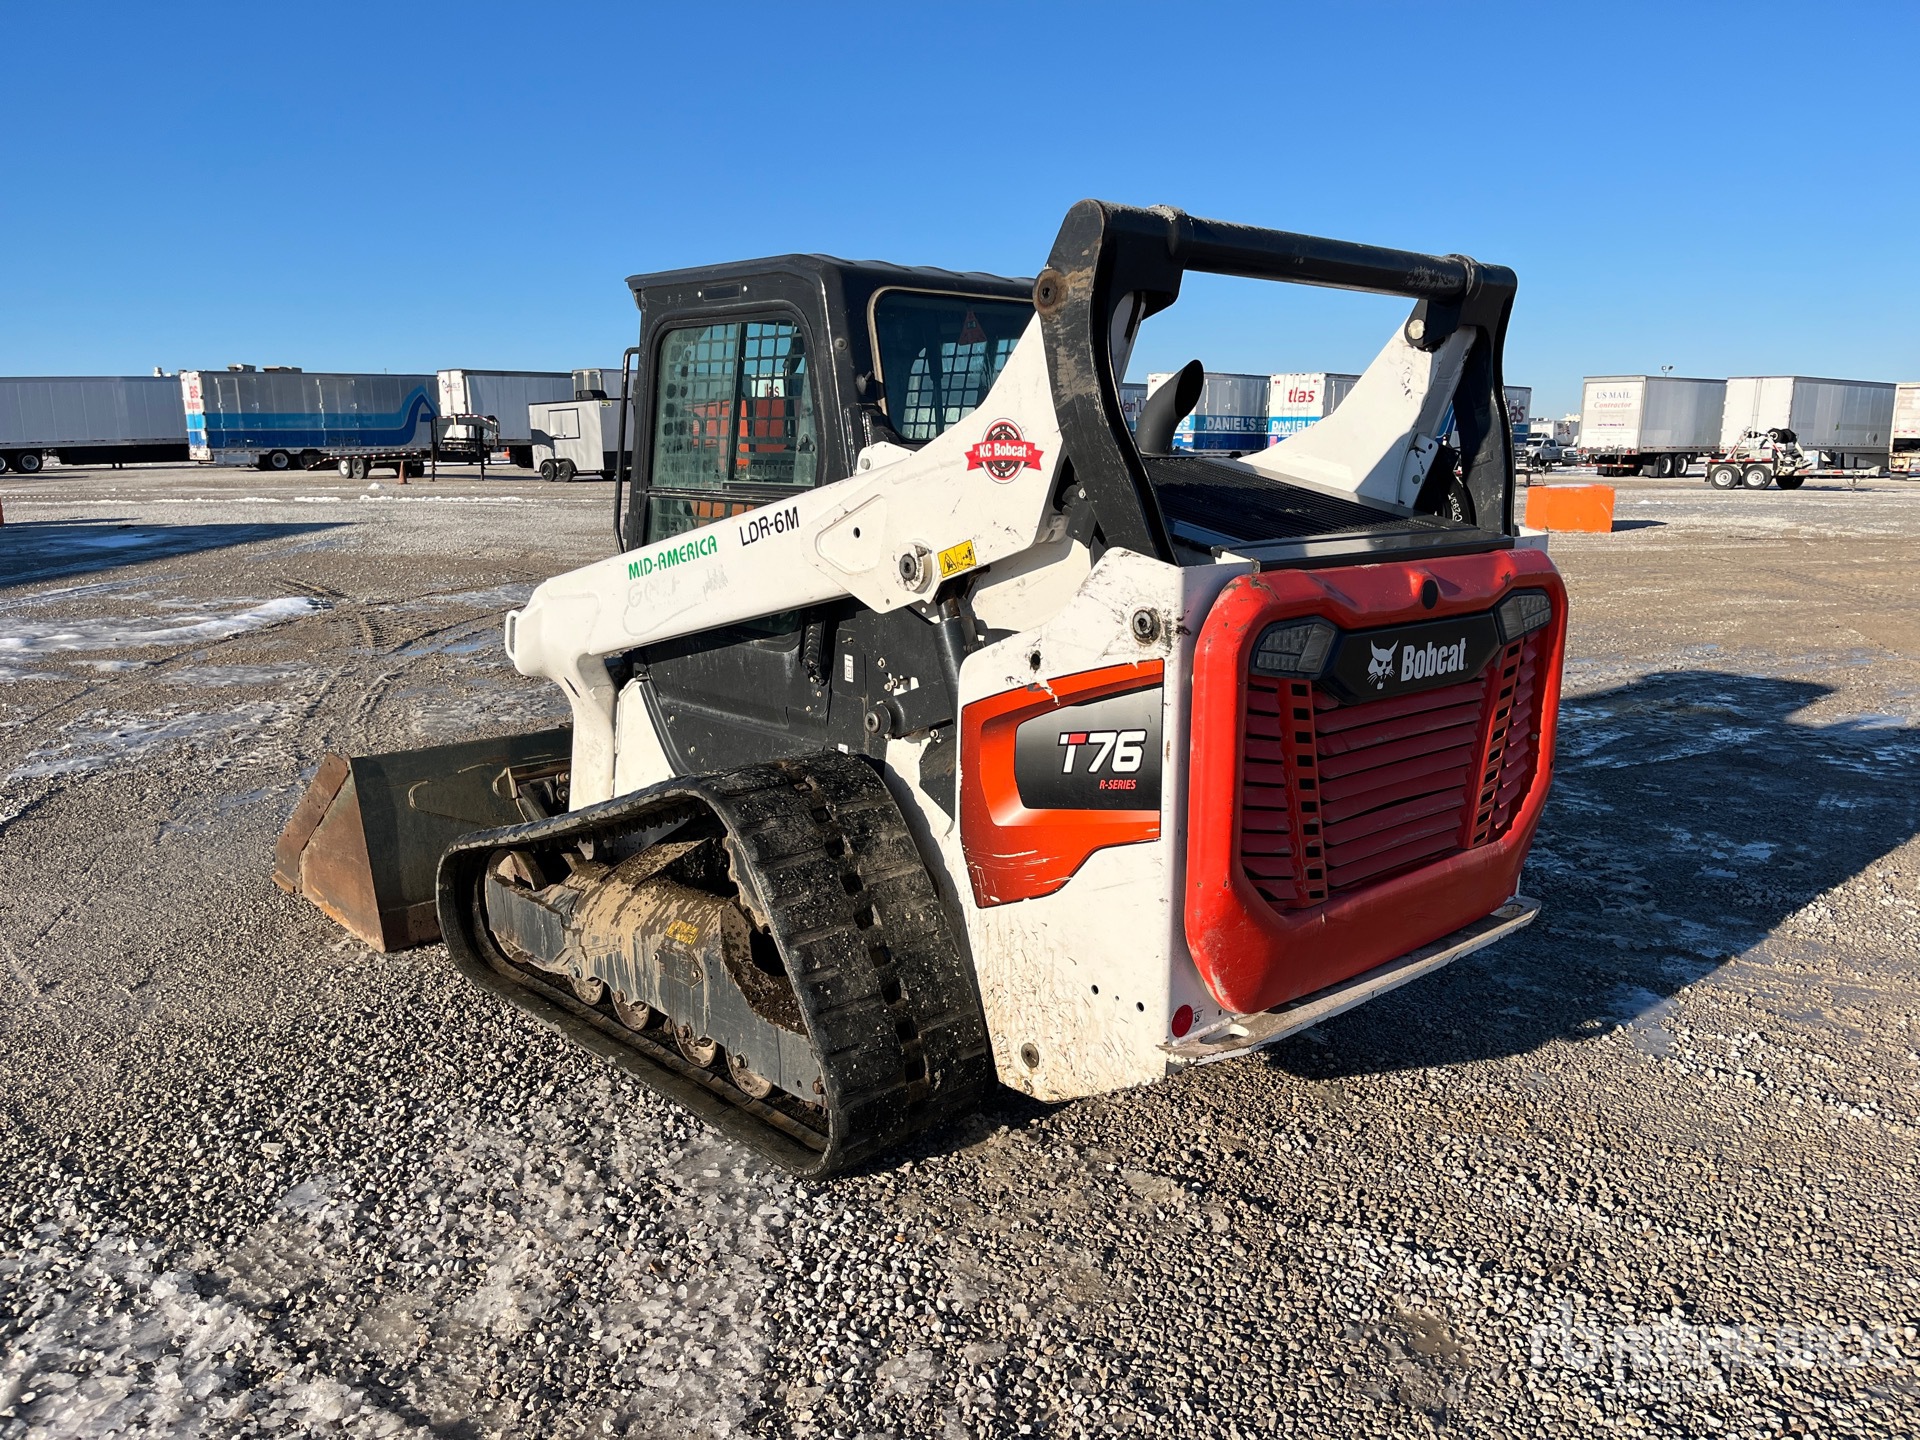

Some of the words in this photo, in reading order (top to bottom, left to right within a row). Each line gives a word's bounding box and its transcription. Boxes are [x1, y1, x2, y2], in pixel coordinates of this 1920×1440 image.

[1288, 386, 1315, 403] tlas
[1596, 391, 1607, 399] US
[1609, 391, 1631, 399] MAIL
[1206, 416, 1257, 431] DANIEL'S
[979, 443, 992, 458] KC
[993, 442, 1027, 458] Bobcat
[739, 506, 800, 546] LDR-6M
[628, 535, 718, 580] MID-AMERICA
[1400, 637, 1466, 682] Bobcat
[1058, 729, 1147, 774] T76
[1099, 779, 1137, 790] R-SERIES
